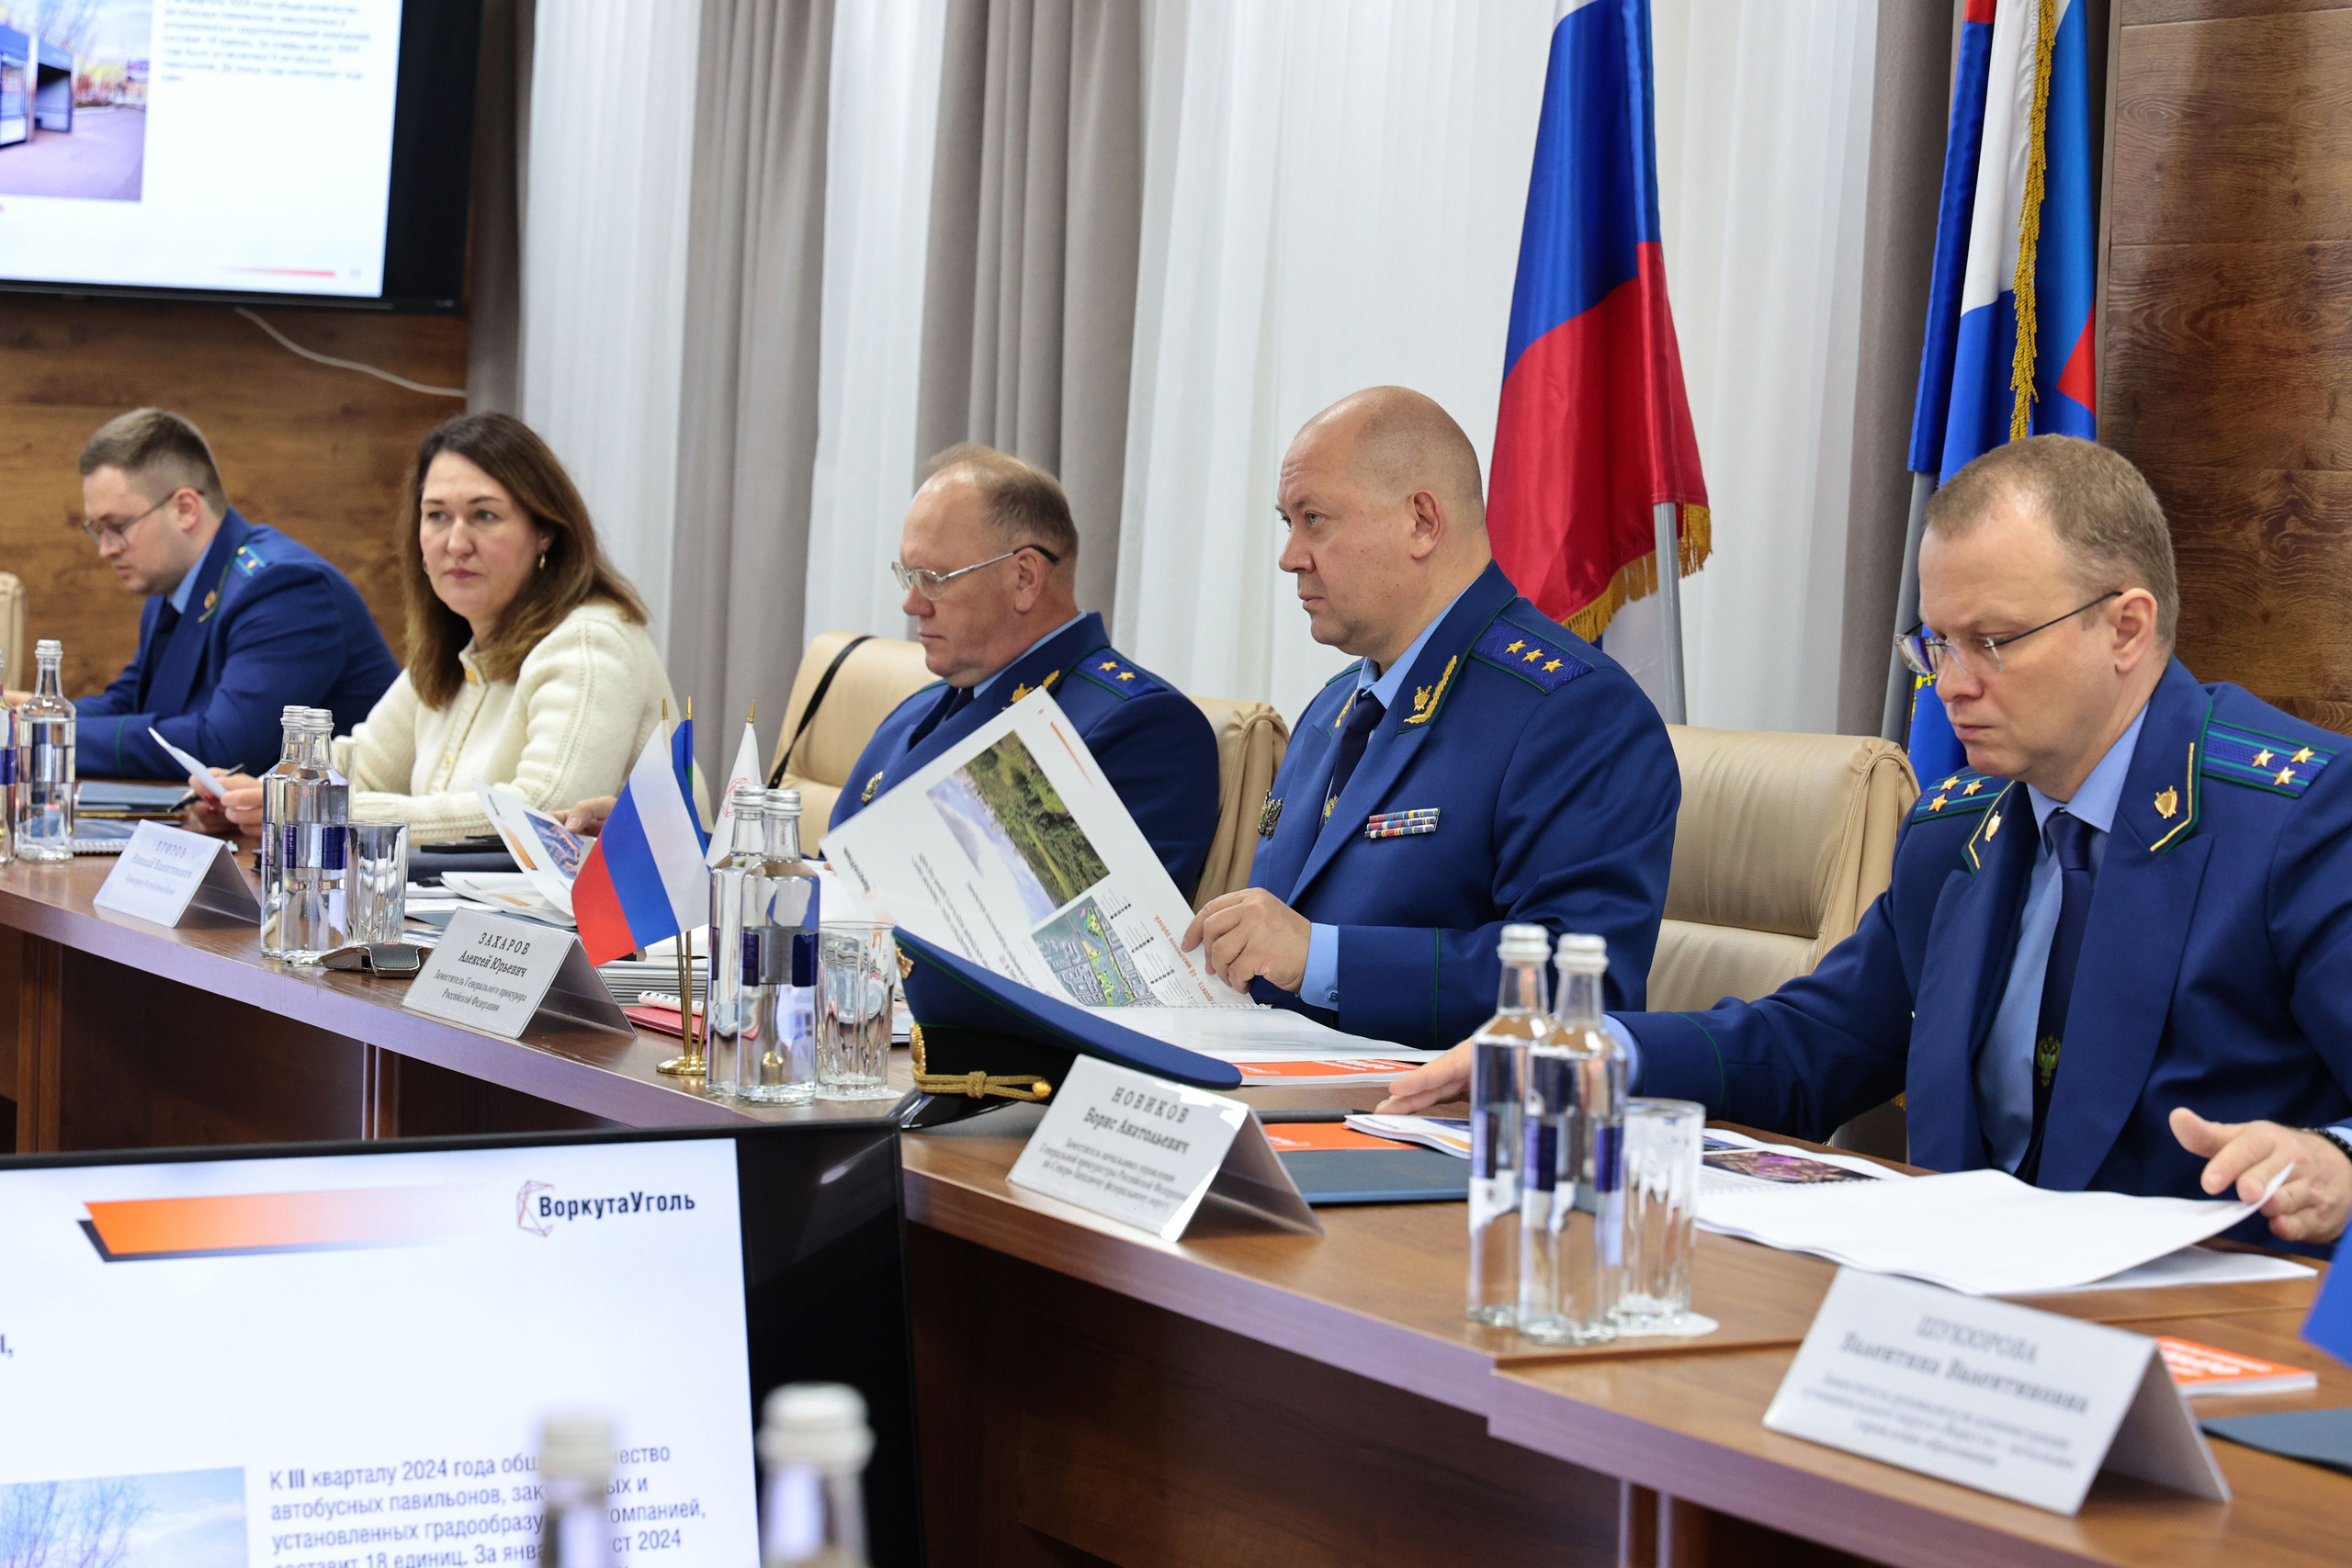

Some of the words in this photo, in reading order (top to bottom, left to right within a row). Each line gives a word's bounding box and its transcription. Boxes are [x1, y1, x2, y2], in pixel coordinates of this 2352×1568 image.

[155, 840, 187, 858] ЕГОРОВ
[1154, 914, 1172, 937] рублей.
[479, 932, 530, 955] ЗАХАРОВ
[1169, 937, 1193, 971] миллионов
[458, 950, 493, 967] Алексей
[490, 957, 527, 976] Юрьевич
[434, 969, 464, 986] Заместитель
[464, 977, 499, 994] Генерального
[499, 988, 527, 1003] прокурора
[442, 988, 472, 1004] Российской
[471, 996, 500, 1011] Федерации
[1111, 1087, 1189, 1122] НОВИКОВ
[1083, 1106, 1117, 1130] Борис
[1116, 1118, 1190, 1155] Анатольевич
[539, 1191, 695, 1221] ВоркутаУголь
[270, 1470, 283, 1490] К
[288, 1469, 305, 1489] III
[311, 1464, 397, 1490] кварталу
[402, 1459, 447, 1481] 2024
[454, 1458, 495, 1478] года
[271, 1496, 384, 1521] автобусных
[390, 1486, 506, 1512] павильонов,
[638, 1478, 648, 1493] и
[271, 1524, 419, 1555] установленных
[424, 1513, 544, 1543] градообразу
[368, 1551, 388, 1568] 18
[474, 1543, 497, 1564] За
[638, 1529, 682, 1551] 2024
